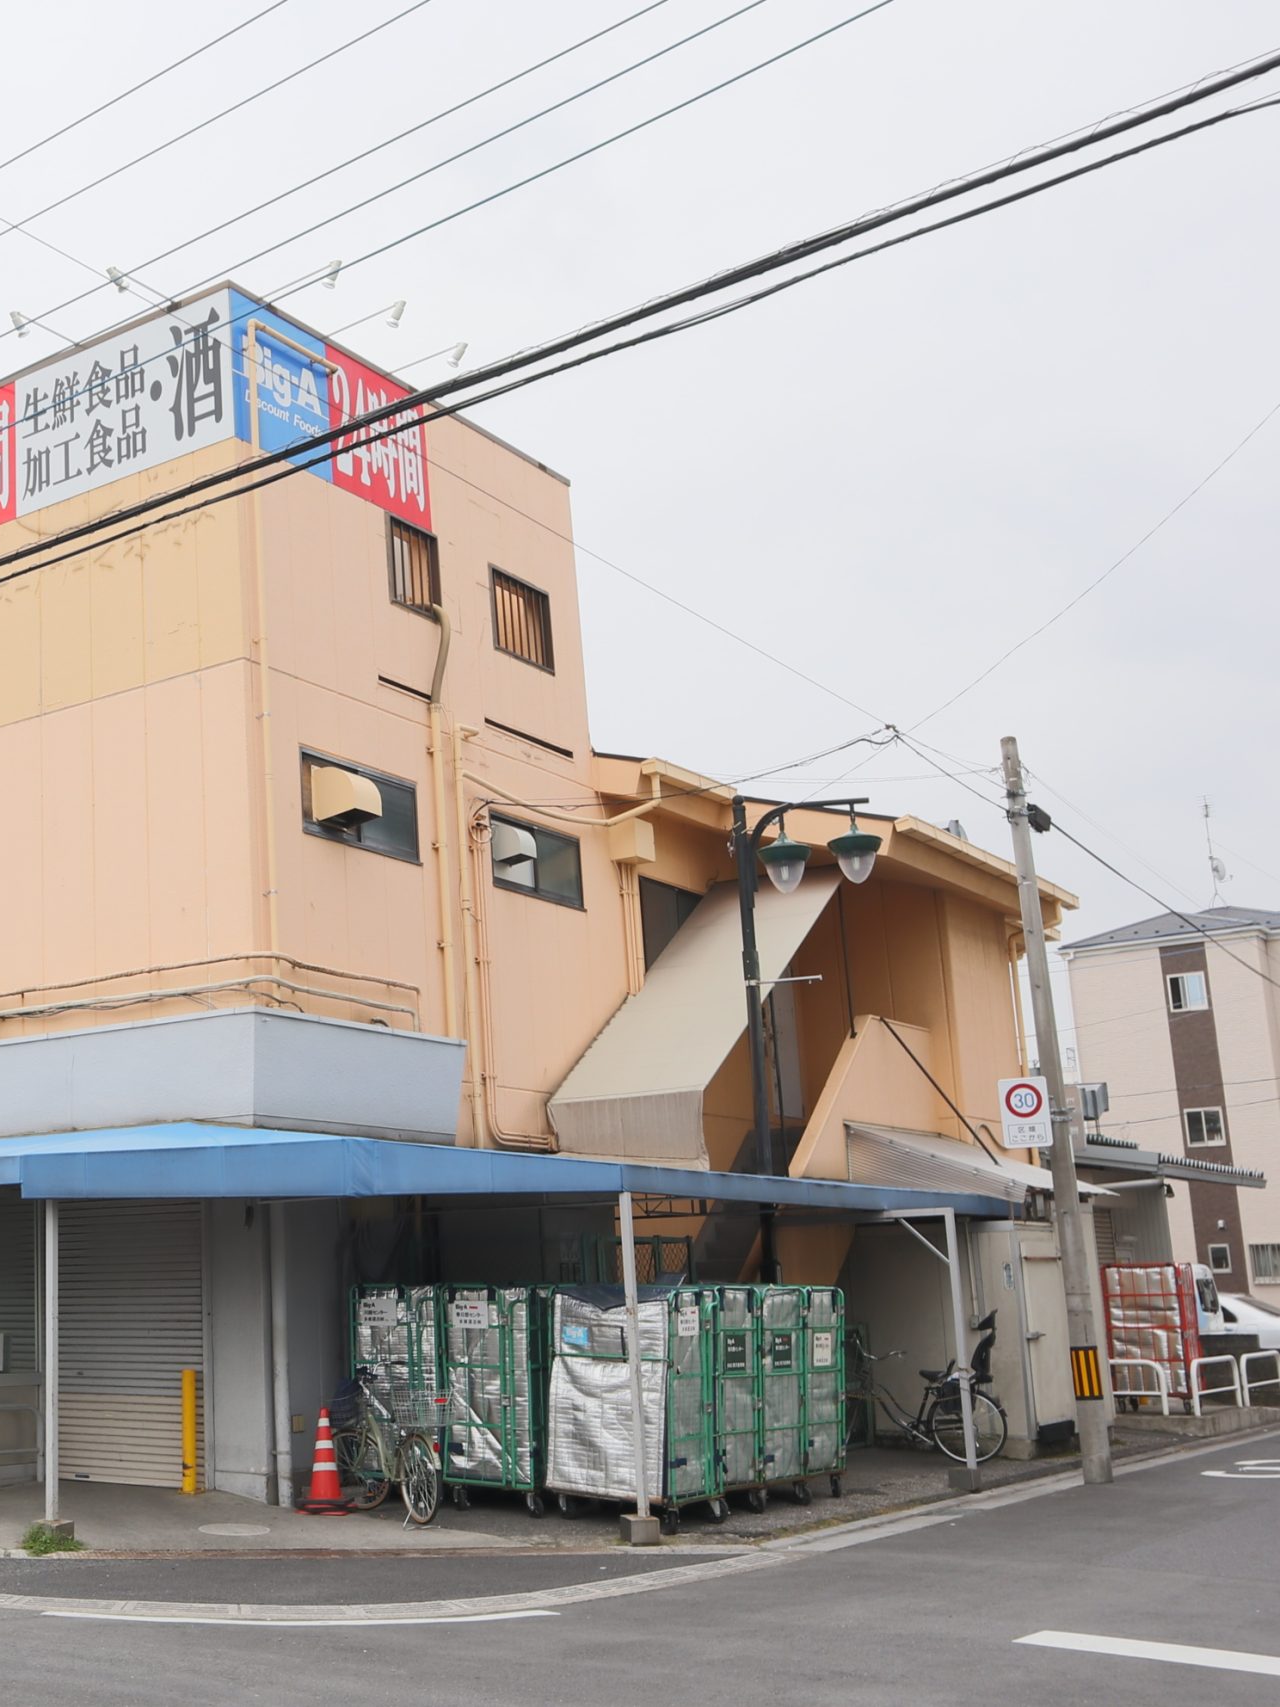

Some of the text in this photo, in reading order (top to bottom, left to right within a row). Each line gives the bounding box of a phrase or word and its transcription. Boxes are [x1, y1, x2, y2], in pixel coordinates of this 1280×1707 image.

[22, 343, 145, 439] 生鮮食品
[22, 403, 147, 501] 加工食品
[1014, 1092, 1035, 1109] 30
